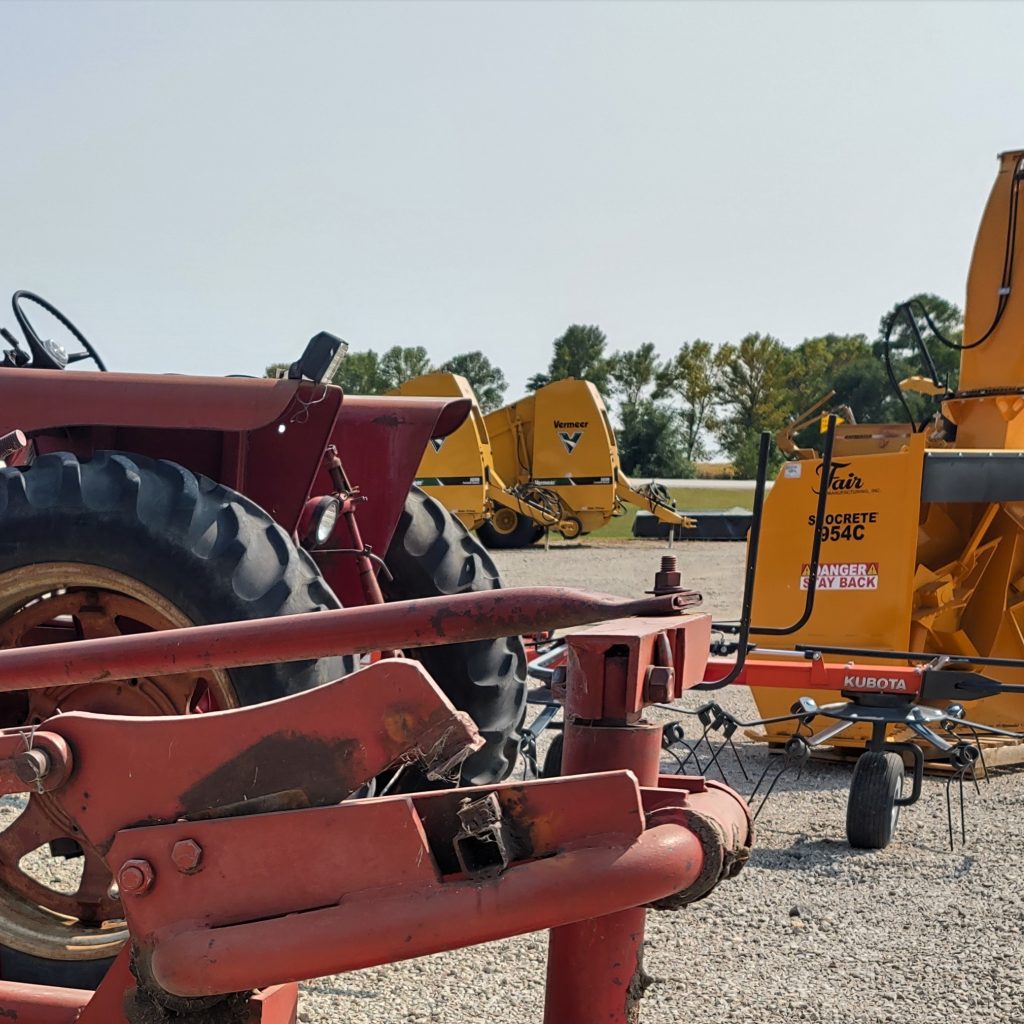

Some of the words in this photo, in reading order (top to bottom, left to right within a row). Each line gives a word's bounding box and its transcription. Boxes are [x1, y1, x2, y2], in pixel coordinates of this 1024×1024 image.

[553, 420, 589, 429] Vermeer
[808, 512, 878, 526] SOCRETE
[803, 577, 835, 588] SAY
[839, 576, 876, 588] BACK
[844, 676, 907, 690] KUBOTA
